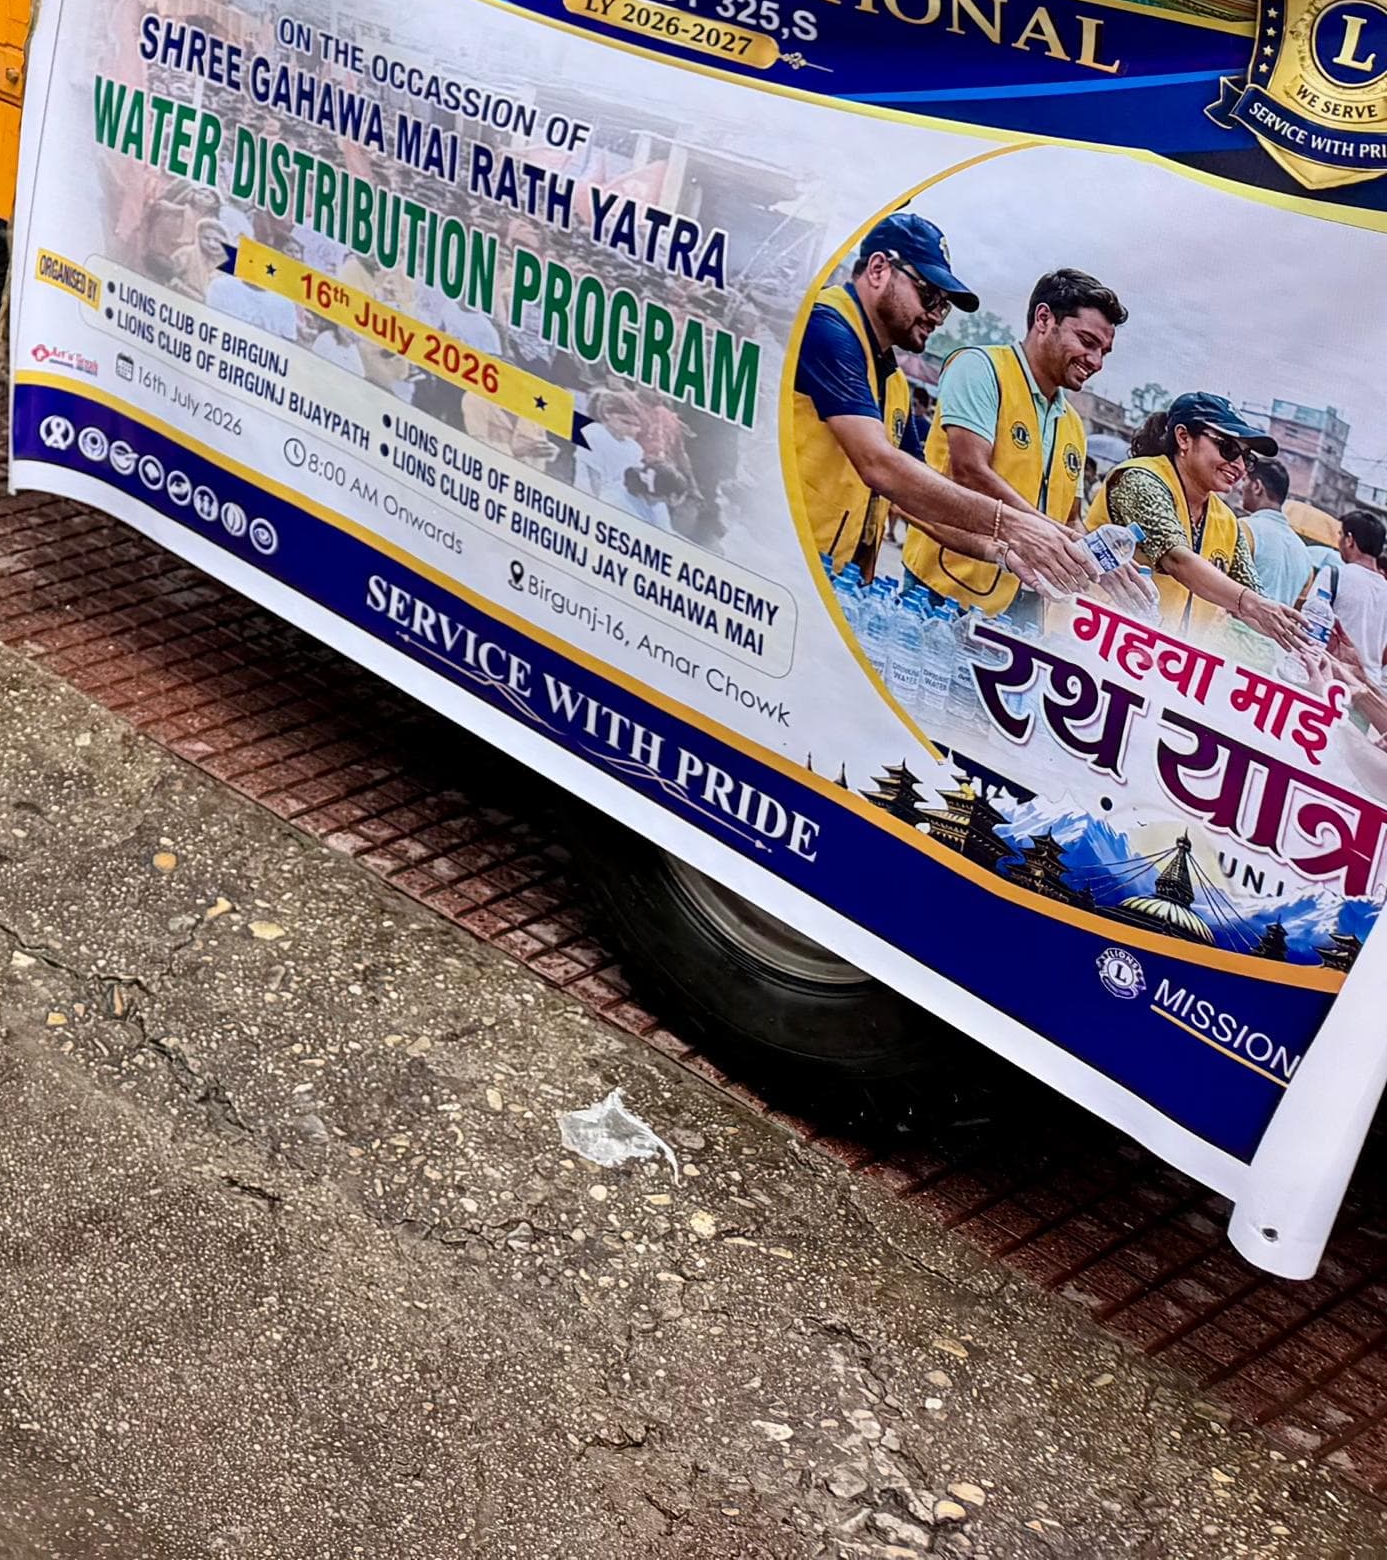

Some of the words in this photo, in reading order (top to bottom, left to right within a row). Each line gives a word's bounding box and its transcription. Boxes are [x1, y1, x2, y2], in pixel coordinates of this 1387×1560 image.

[277, 18, 312, 50] ON
[319, 30, 367, 74] THE
[370, 44, 538, 139] OCCASSION
[544, 115, 590, 153] OF
[620, 3, 753, 57] 2026-2027
[1332, 14, 1376, 72] L
[139, 14, 243, 92] SHREE
[250, 64, 386, 153] GAHAWA
[394, 117, 459, 183] MAI
[470, 148, 575, 232] RATH
[590, 187, 728, 289] YATRA
[1248, 102, 1308, 145] SERVICE
[1310, 134, 1354, 158] WITH
[1359, 142, 1387, 159] PRI
[1296, 84, 1318, 109] WE
[1320, 100, 1378, 119] SERVE
[38, 253, 87, 295] ORGANISED
[87, 280, 99, 303] BY
[93, 74, 222, 187] WATER
[230, 123, 498, 316] DISTRIBUTION
[513, 253, 761, 429] PROGRAM
[116, 309, 154, 344] LIONS
[156, 330, 192, 363] CLUB
[195, 348, 216, 373] OF
[217, 358, 285, 406] BIRGUNJ
[288, 391, 371, 451] BIJAYPATH
[119, 282, 156, 317] LIONS
[158, 303, 195, 336] CLUB
[198, 322, 218, 344] OF
[220, 331, 289, 378] BIRGUNJ
[300, 271, 351, 314] 16th
[354, 298, 415, 356] July
[423, 333, 500, 394] 2026
[137, 365, 168, 397] 16th
[169, 386, 200, 418] July
[203, 402, 243, 436] 2026
[307, 452, 347, 487] 8:00
[349, 477, 379, 506] AM
[383, 494, 464, 555] Onwards
[392, 446, 436, 488] LIONS
[439, 473, 480, 513] CLUB
[484, 498, 507, 525] OF
[510, 511, 588, 568] BIRGUNJ
[591, 554, 629, 588] JAY
[633, 573, 719, 634] GAHAWA
[724, 616, 765, 657] MAI
[395, 416, 439, 459] LIONS
[442, 443, 483, 482] CLUB
[487, 468, 510, 495] OF
[513, 480, 591, 536] BIRGUNJ
[594, 520, 673, 578] SESAME
[676, 562, 780, 627] ACADEMY
[528, 573, 631, 647] Birgunj-16,
[635, 633, 701, 680] Amar
[705, 667, 791, 727] Chowk
[970, 622, 1146, 779] रथ
[1072, 597, 1226, 706] गहवा
[1229, 684, 1347, 766] माई
[364, 573, 533, 701] SERVICE
[542, 673, 665, 773] WITH
[675, 748, 821, 864] PRIDE
[1114, 963, 1127, 984] L
[1154, 978, 1301, 1079] MISSION
